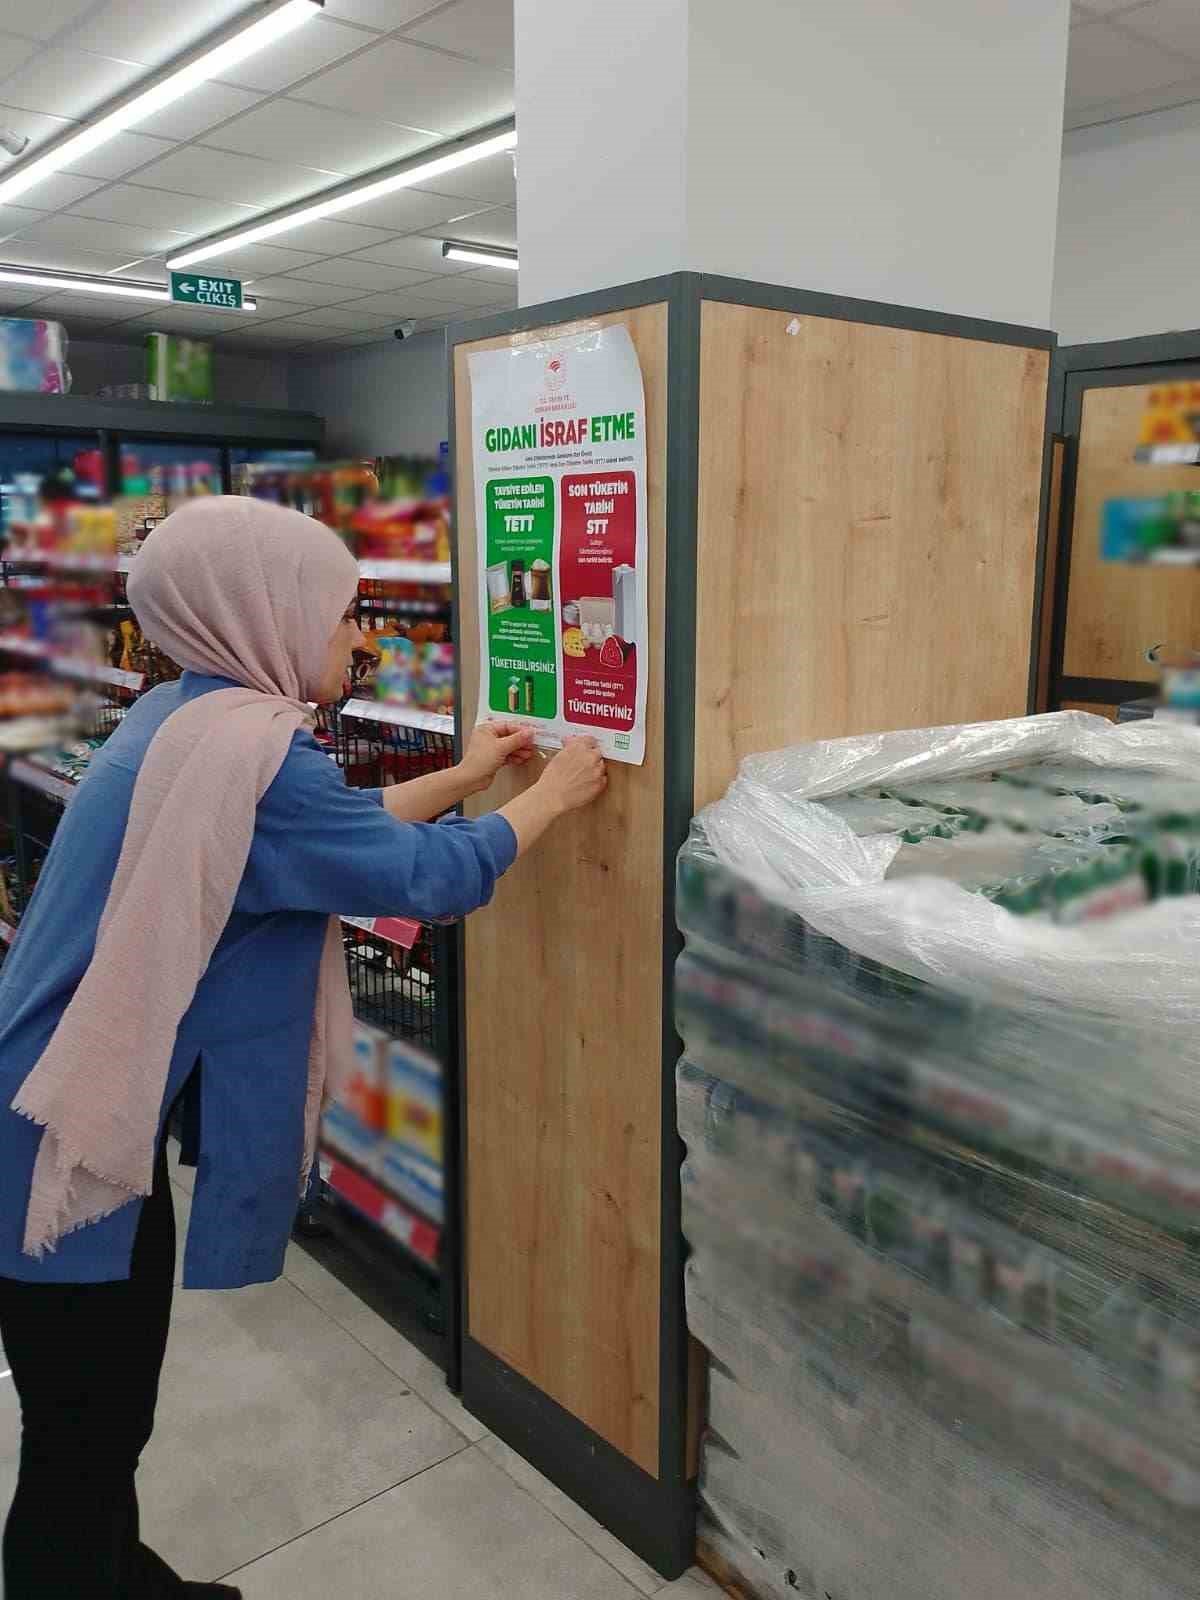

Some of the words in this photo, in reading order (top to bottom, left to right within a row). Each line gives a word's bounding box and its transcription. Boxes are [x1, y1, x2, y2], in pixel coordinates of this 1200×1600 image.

[198, 280, 234, 293] EXIT
[196, 291, 237, 307] ÇIKIŞ
[485, 424, 537, 452] GIDANI
[540, 417, 588, 447] İSRAF
[591, 412, 635, 442] ETME
[568, 484, 588, 496] SON
[584, 498, 614, 514] TARİHİ
[504, 514, 535, 532] TETT
[586, 519, 609, 534] STT
[567, 698, 633, 721] TÜKETMEYİNİZ
